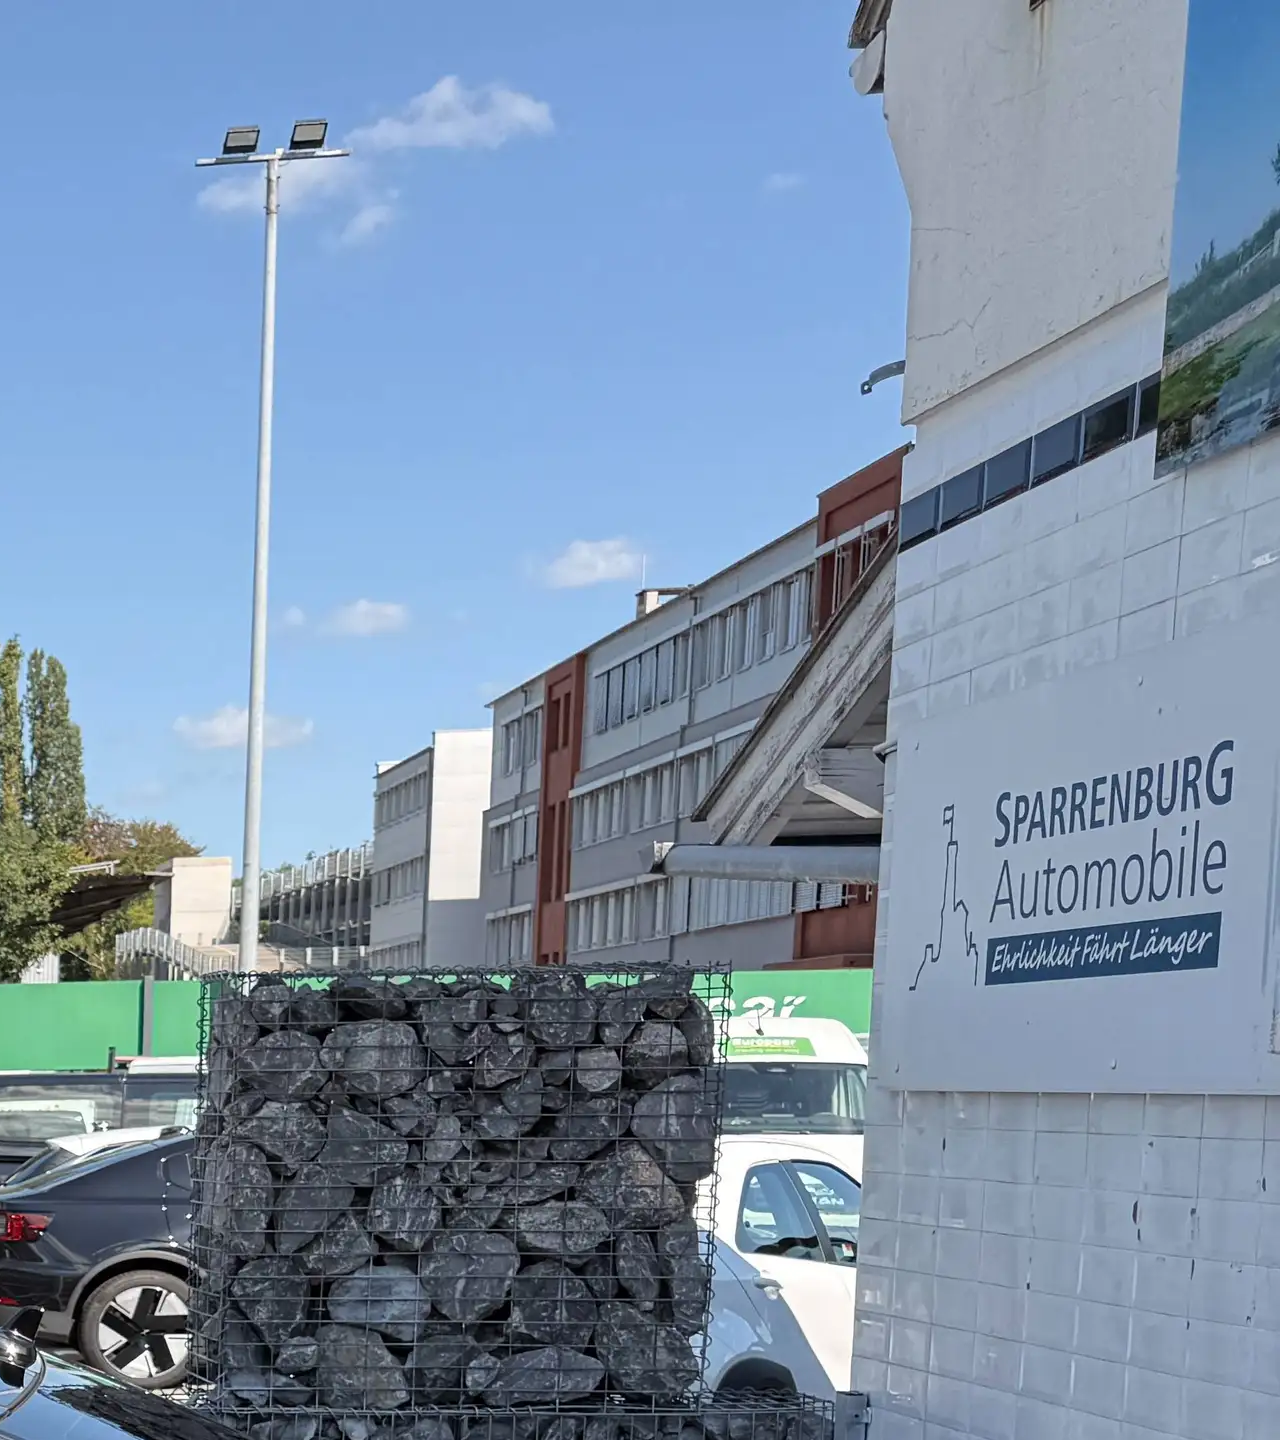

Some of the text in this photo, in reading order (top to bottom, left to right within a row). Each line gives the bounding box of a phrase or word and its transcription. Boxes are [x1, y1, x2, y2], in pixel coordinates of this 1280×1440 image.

[994, 739, 1234, 848] SPARRENBURG
[989, 819, 1227, 924] Automobile
[991, 926, 1213, 974] Ehrlichkeit Fährt Länger
